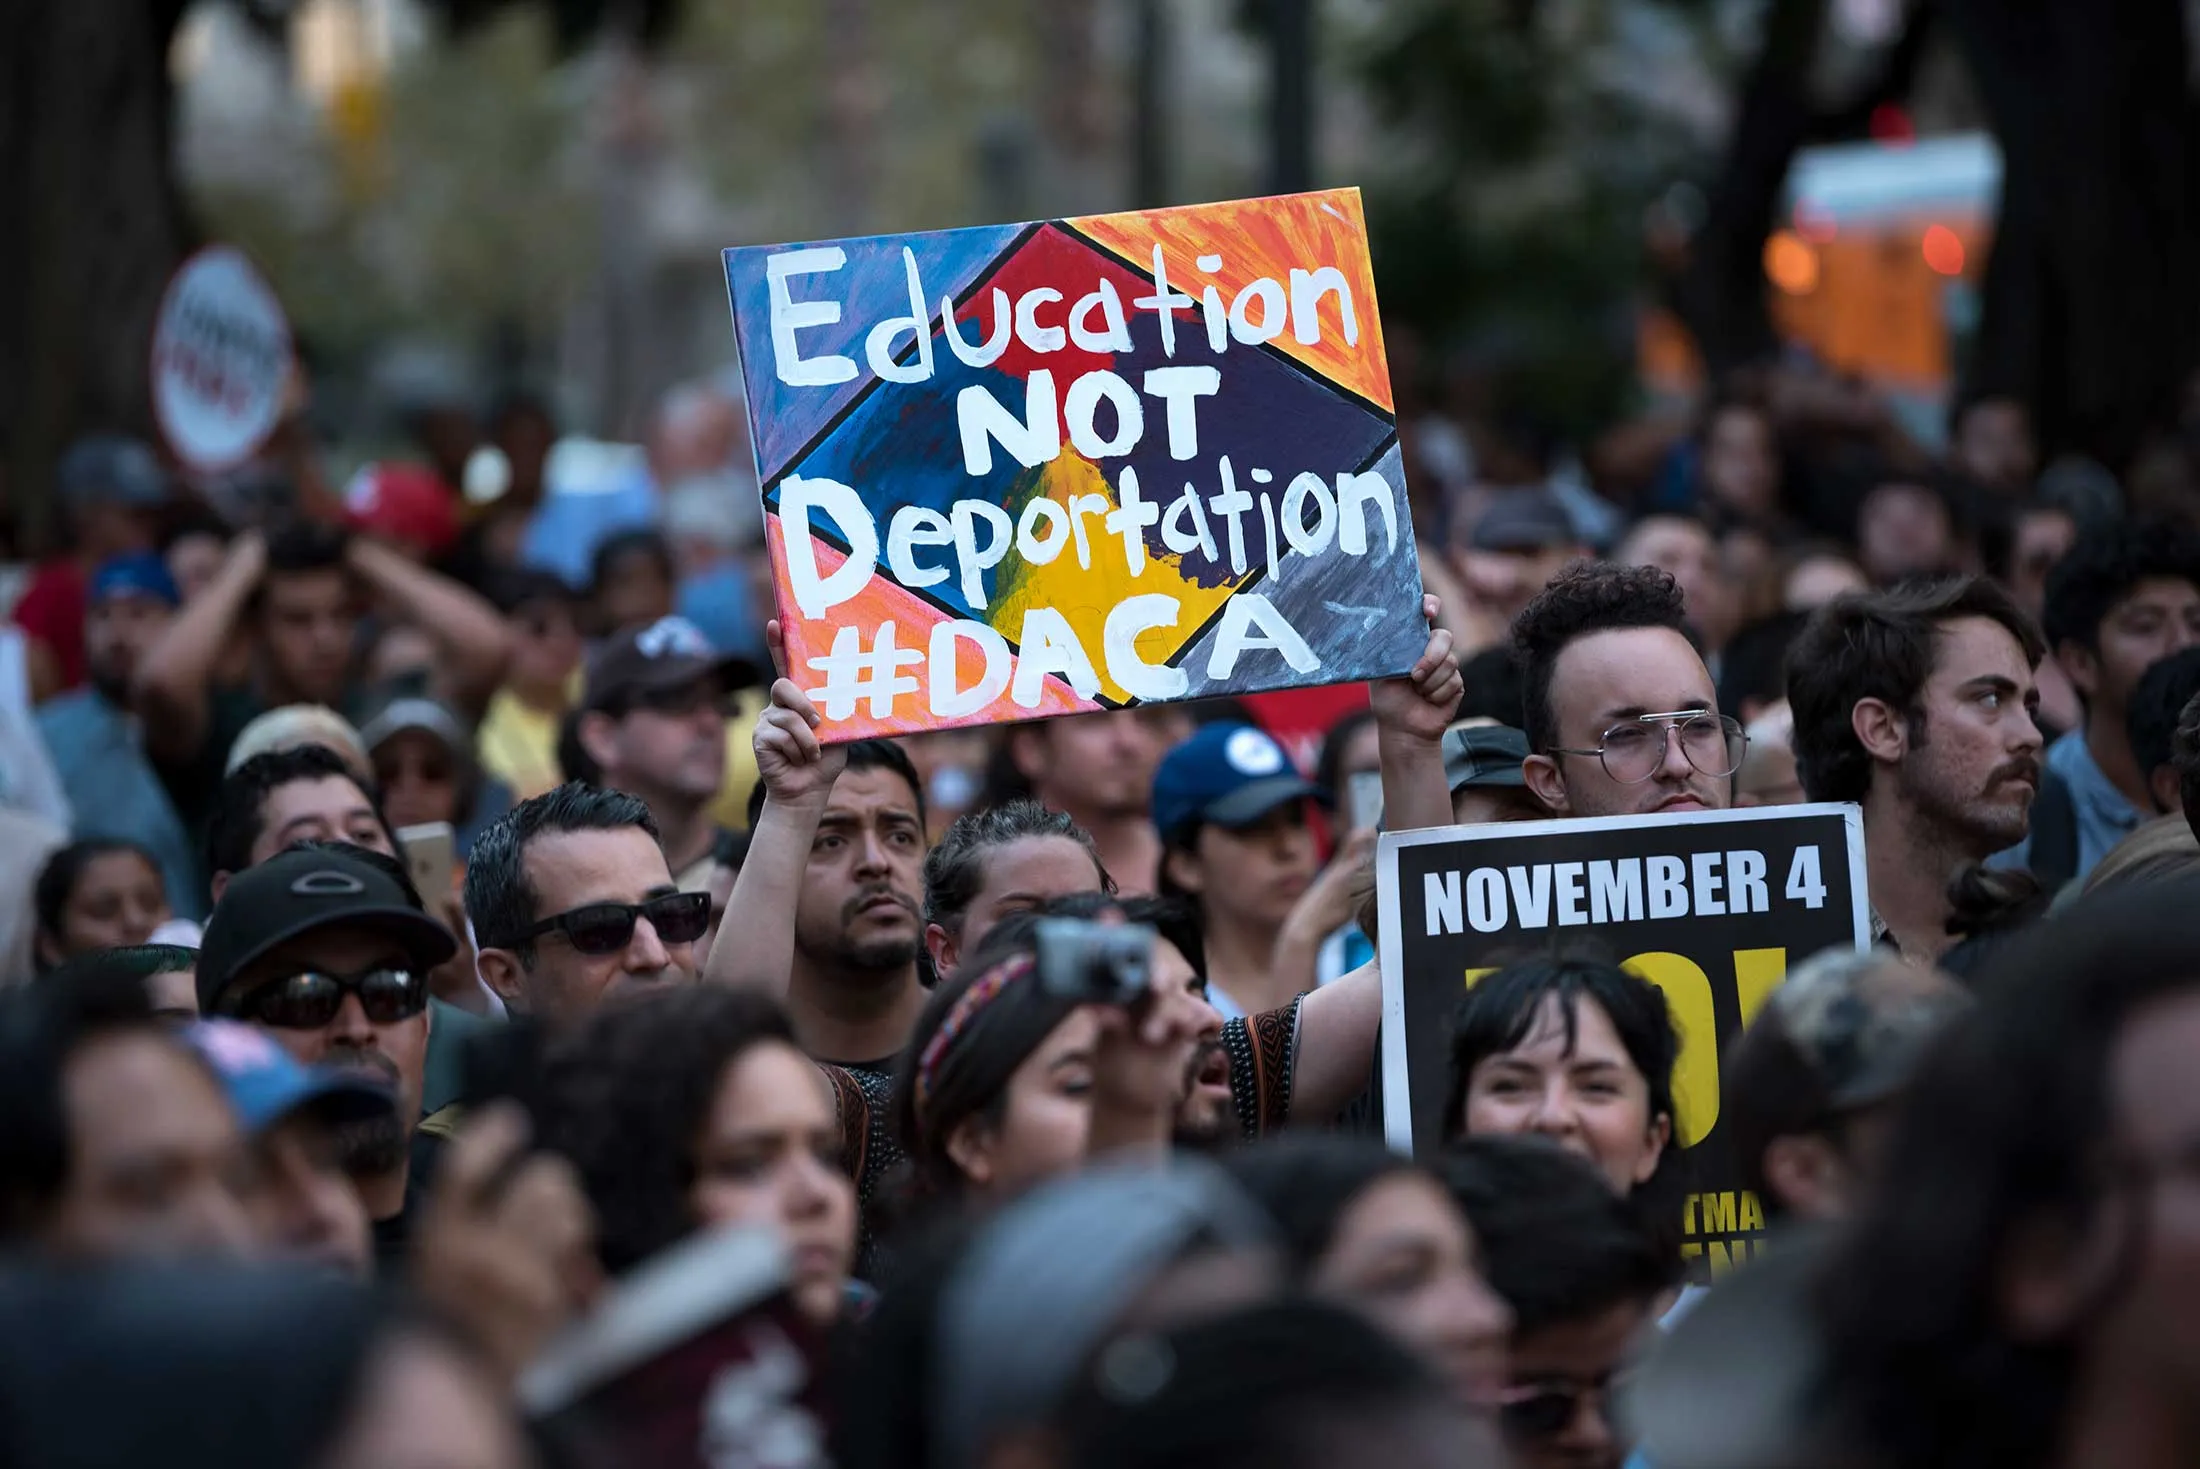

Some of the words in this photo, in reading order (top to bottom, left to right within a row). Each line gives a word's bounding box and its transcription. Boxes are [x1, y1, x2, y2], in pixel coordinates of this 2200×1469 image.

[766, 243, 1360, 387] Education
[956, 366, 1221, 477] NOT
[778, 455, 1398, 620] Deportation
[804, 592, 1321, 723] #DACA
[1423, 849, 1770, 937] NOVEMBER
[1785, 845, 1827, 909] 4
